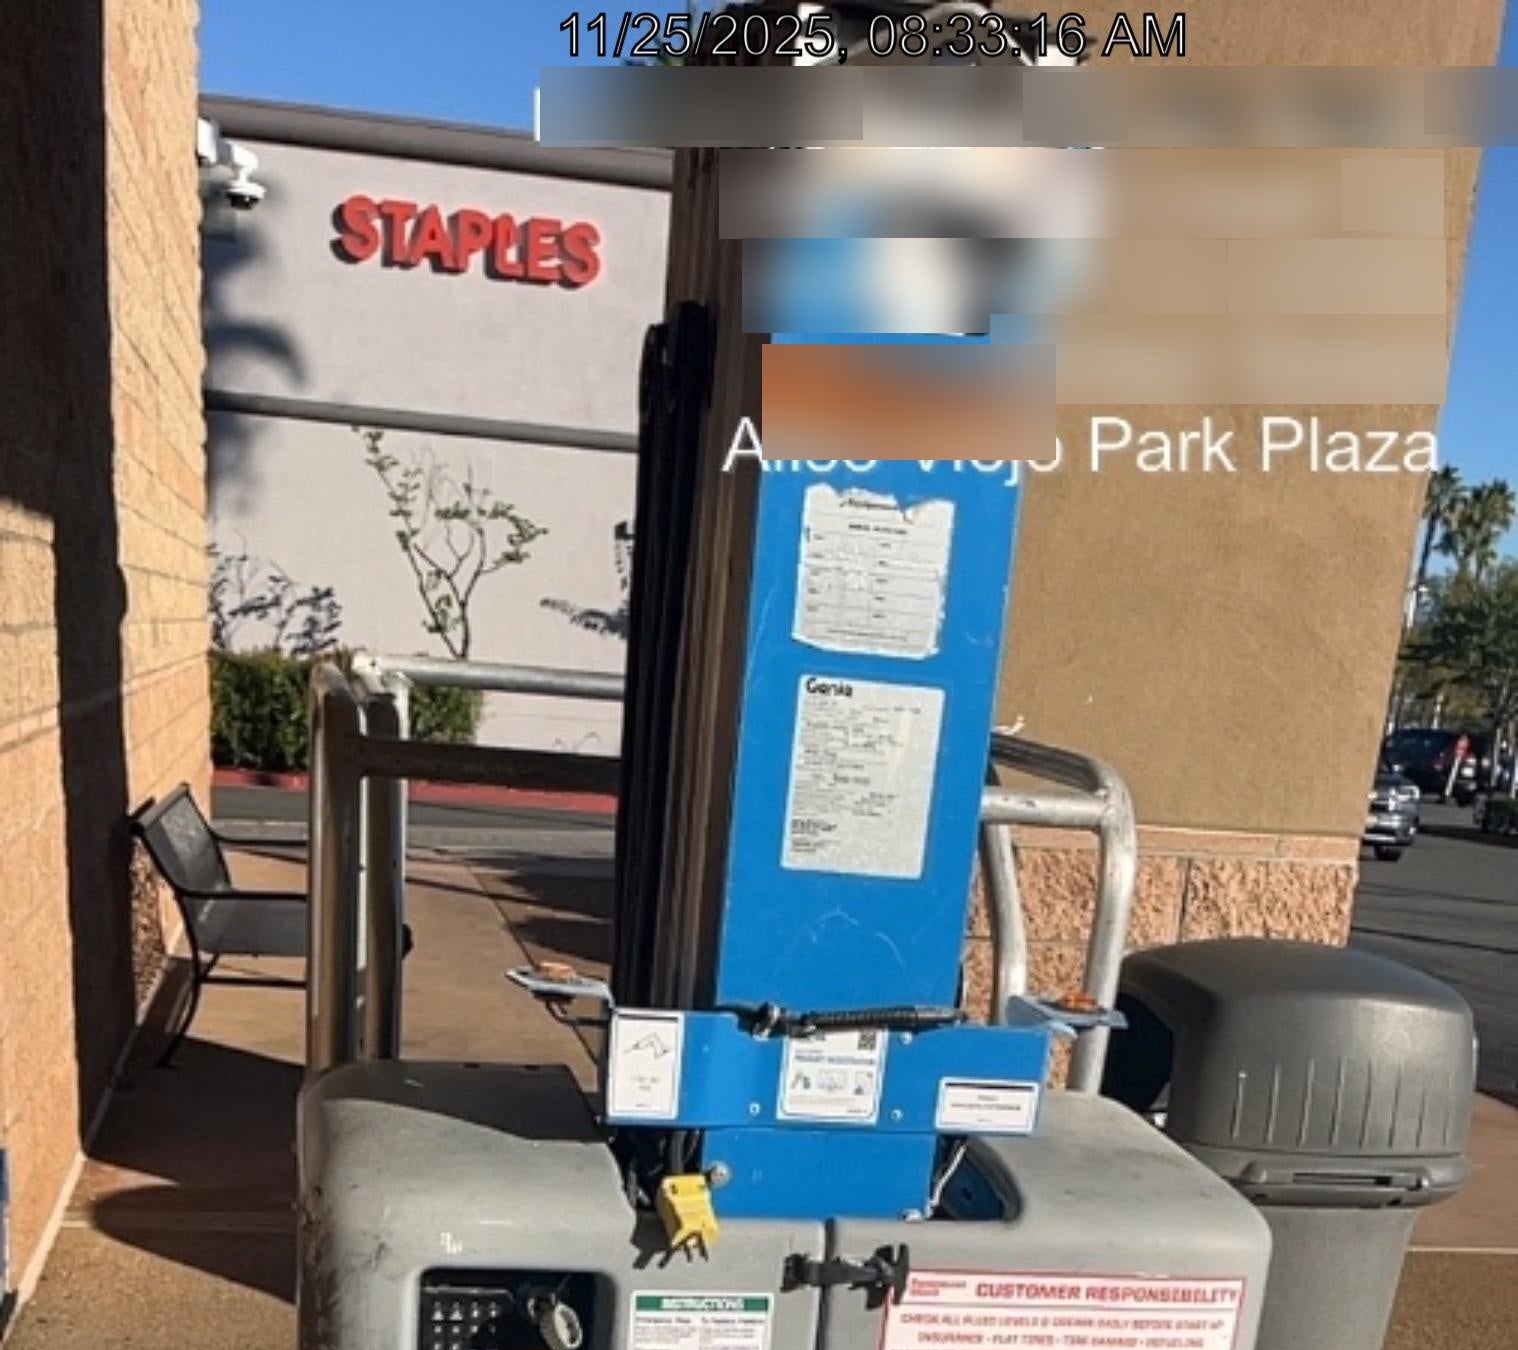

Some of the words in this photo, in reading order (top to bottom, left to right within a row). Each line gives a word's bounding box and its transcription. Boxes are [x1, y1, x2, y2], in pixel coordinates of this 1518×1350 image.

[329, 195, 601, 290] STAPLES
[974, 1283, 1082, 1300] CUSTOMER
[1086, 1286, 1238, 1304] RESPONSIBILITY
[918, 1332, 984, 1345] INSURANCE
